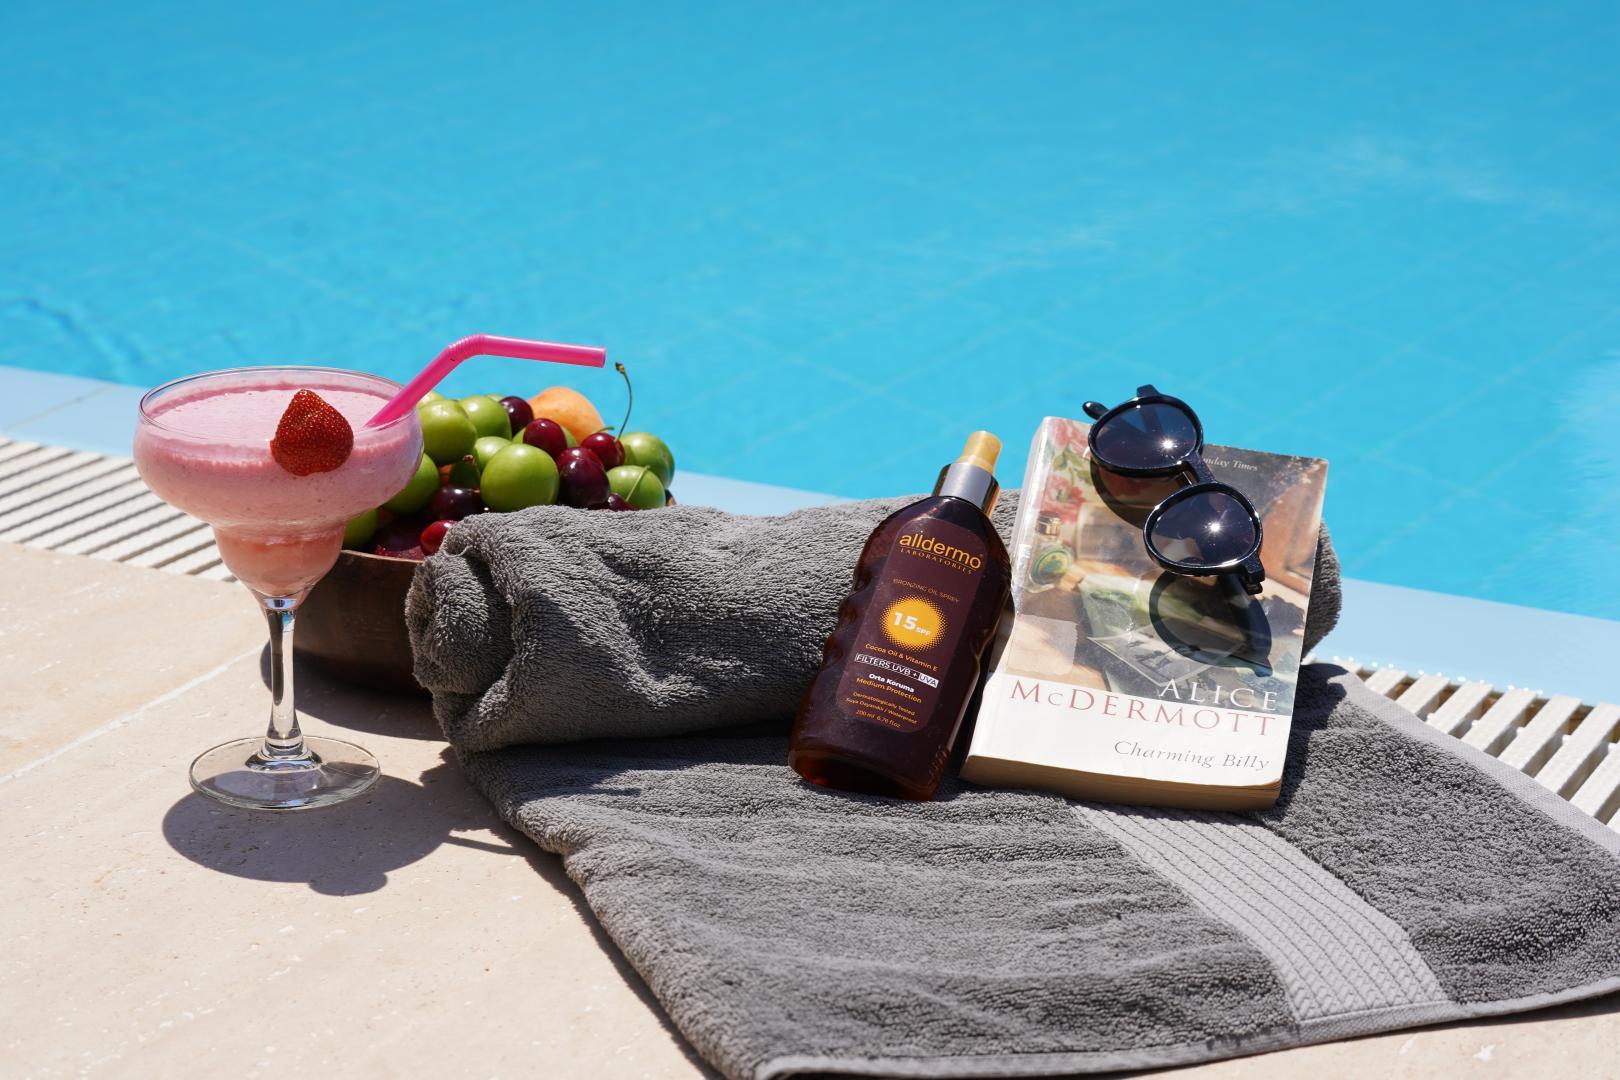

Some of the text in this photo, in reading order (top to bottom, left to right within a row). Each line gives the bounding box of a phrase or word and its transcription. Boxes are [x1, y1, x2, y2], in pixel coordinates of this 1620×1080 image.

[1203, 457, 1258, 472] unday Times
[899, 533, 981, 569] alldermo
[900, 548, 972, 575] LABORATORIES
[894, 611, 918, 630] 15
[856, 653, 890, 668] FILTERS
[892, 664, 912, 676] UVB
[919, 674, 937, 687] UVA
[865, 643, 886, 654] Cocoa
[888, 649, 898, 657] Oil
[905, 655, 932, 670] Vitamin
[933, 664, 939, 672] E
[856, 677, 923, 704] Medium Protection
[868, 673, 915, 693] Orta Koruma
[1158, 678, 1278, 711] ALICE
[1113, 740, 1271, 771] Charming Billy
